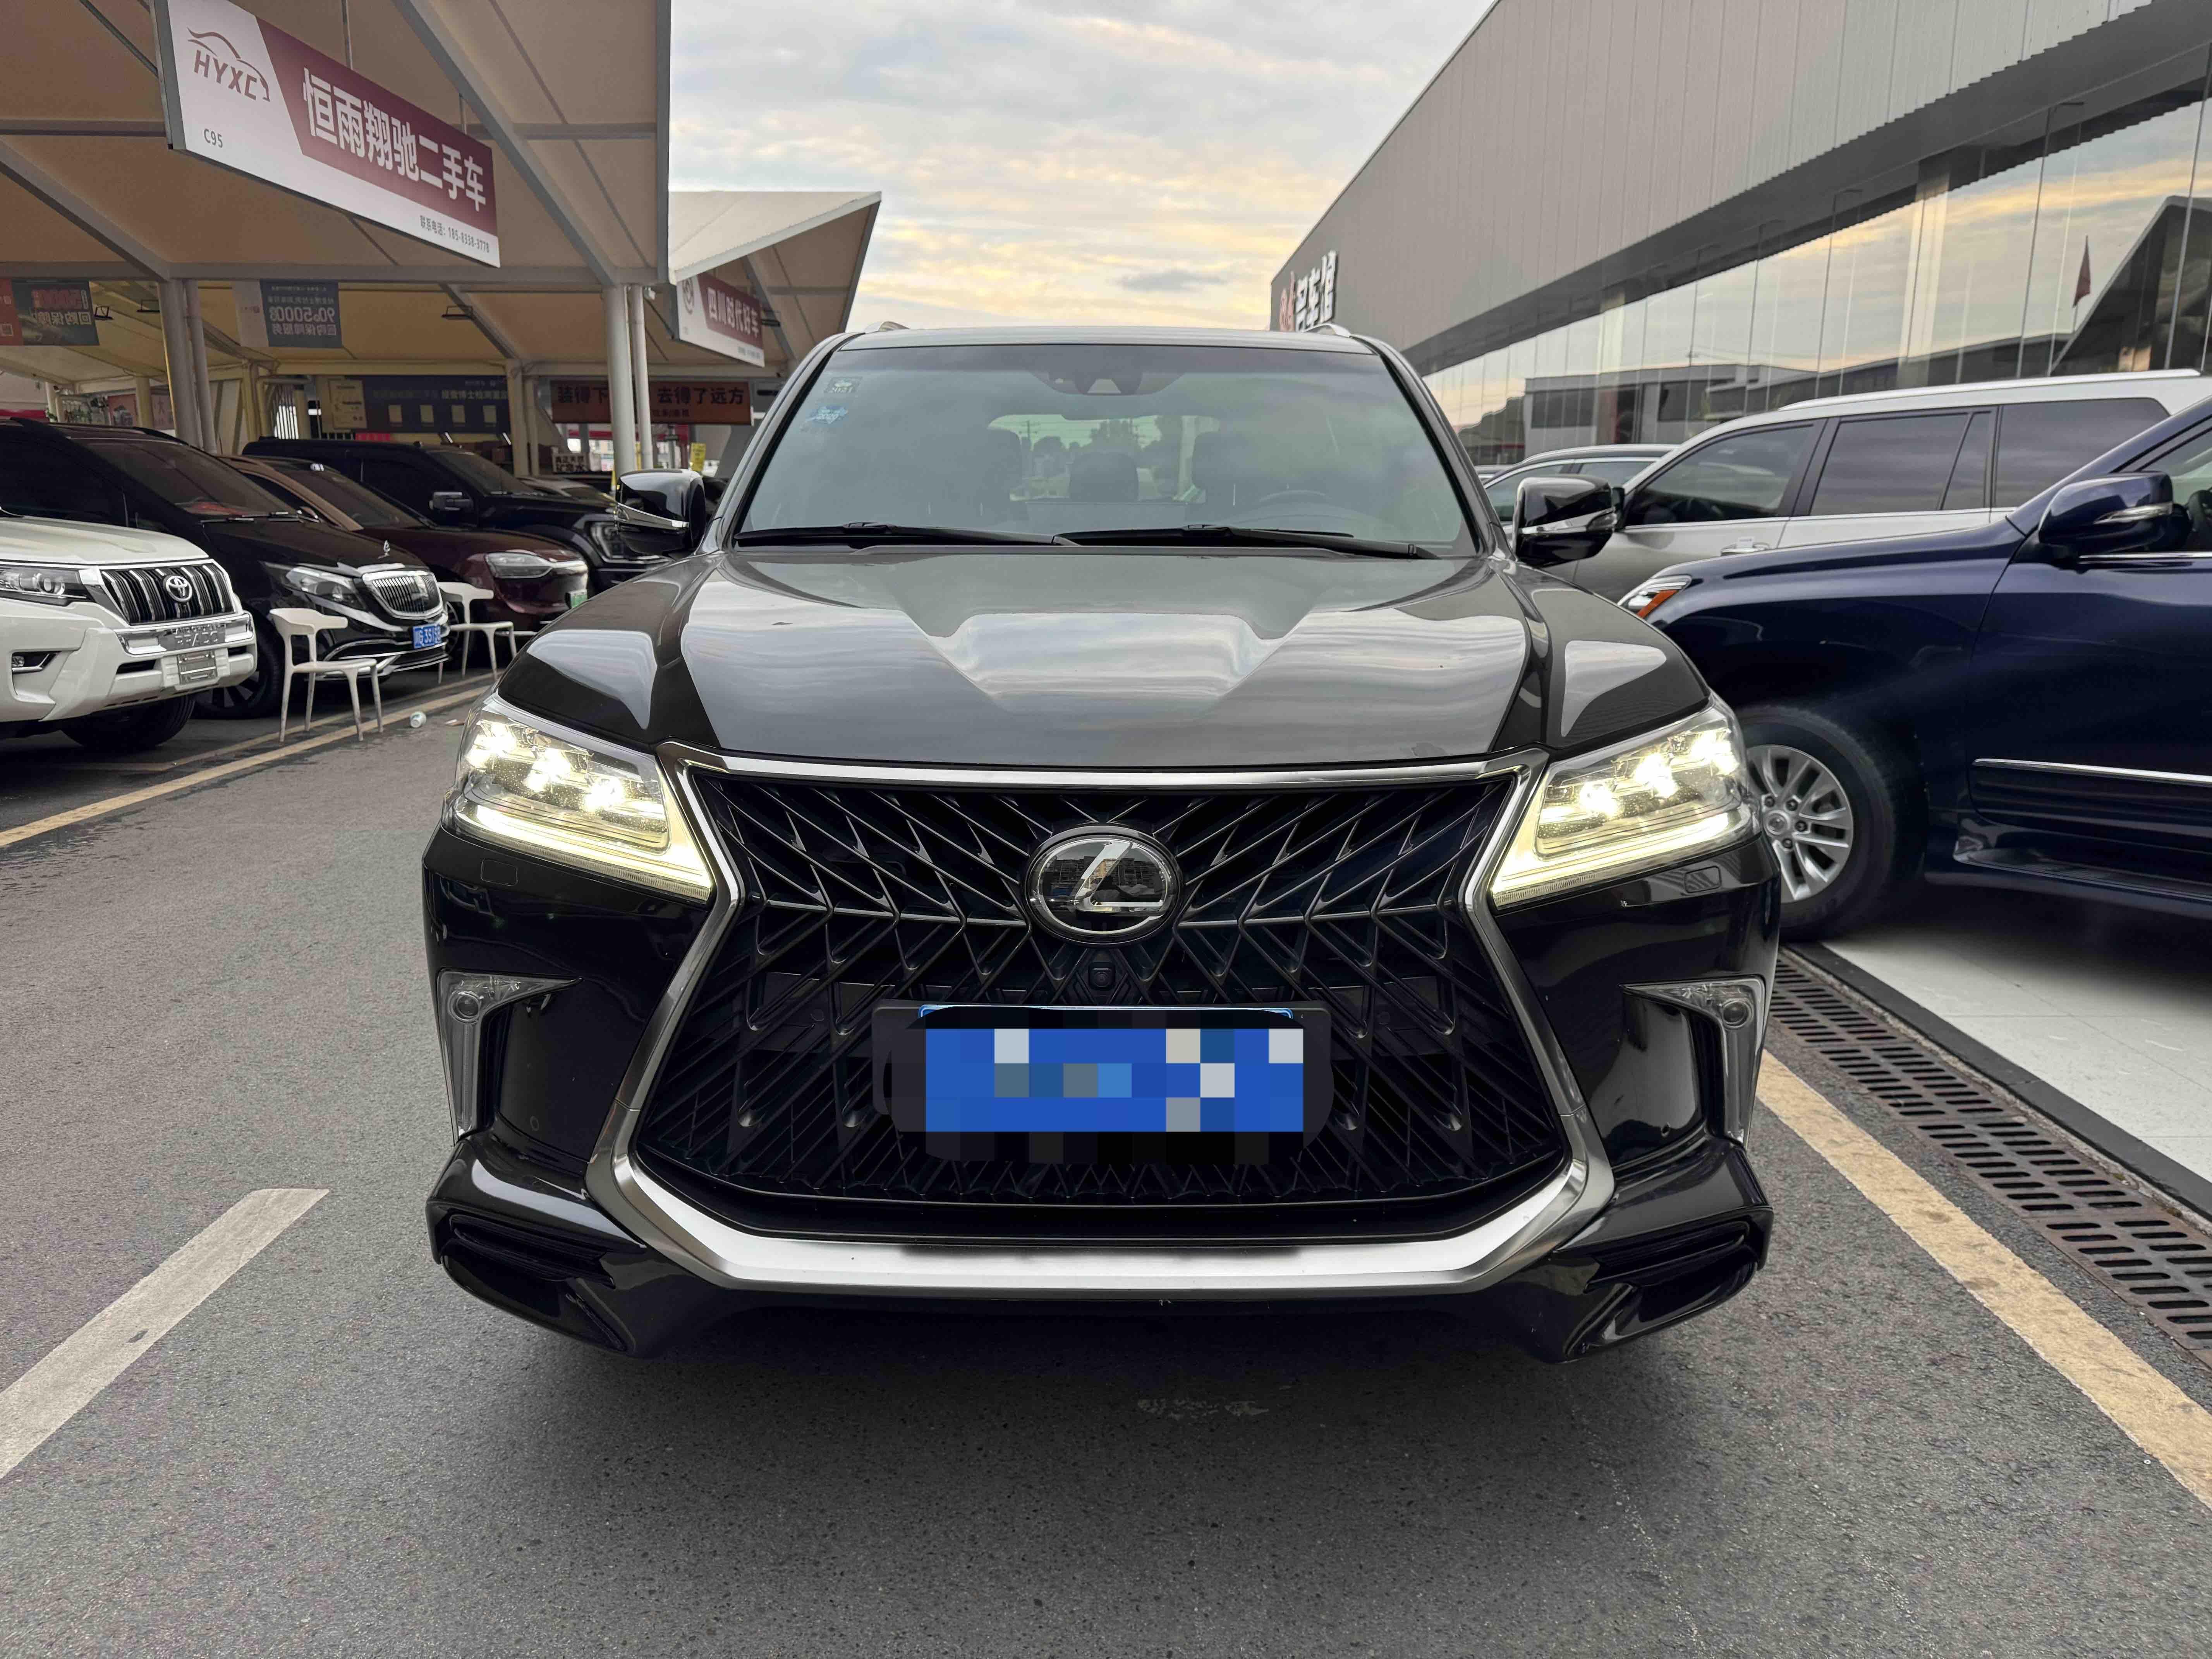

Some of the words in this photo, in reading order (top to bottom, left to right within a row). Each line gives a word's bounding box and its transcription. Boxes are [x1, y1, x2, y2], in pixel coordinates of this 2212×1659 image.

[194, 49, 257, 101] HYXC
[204, 128, 223, 148] C95
[303, 67, 486, 212] 恒雨翔驰二手车
